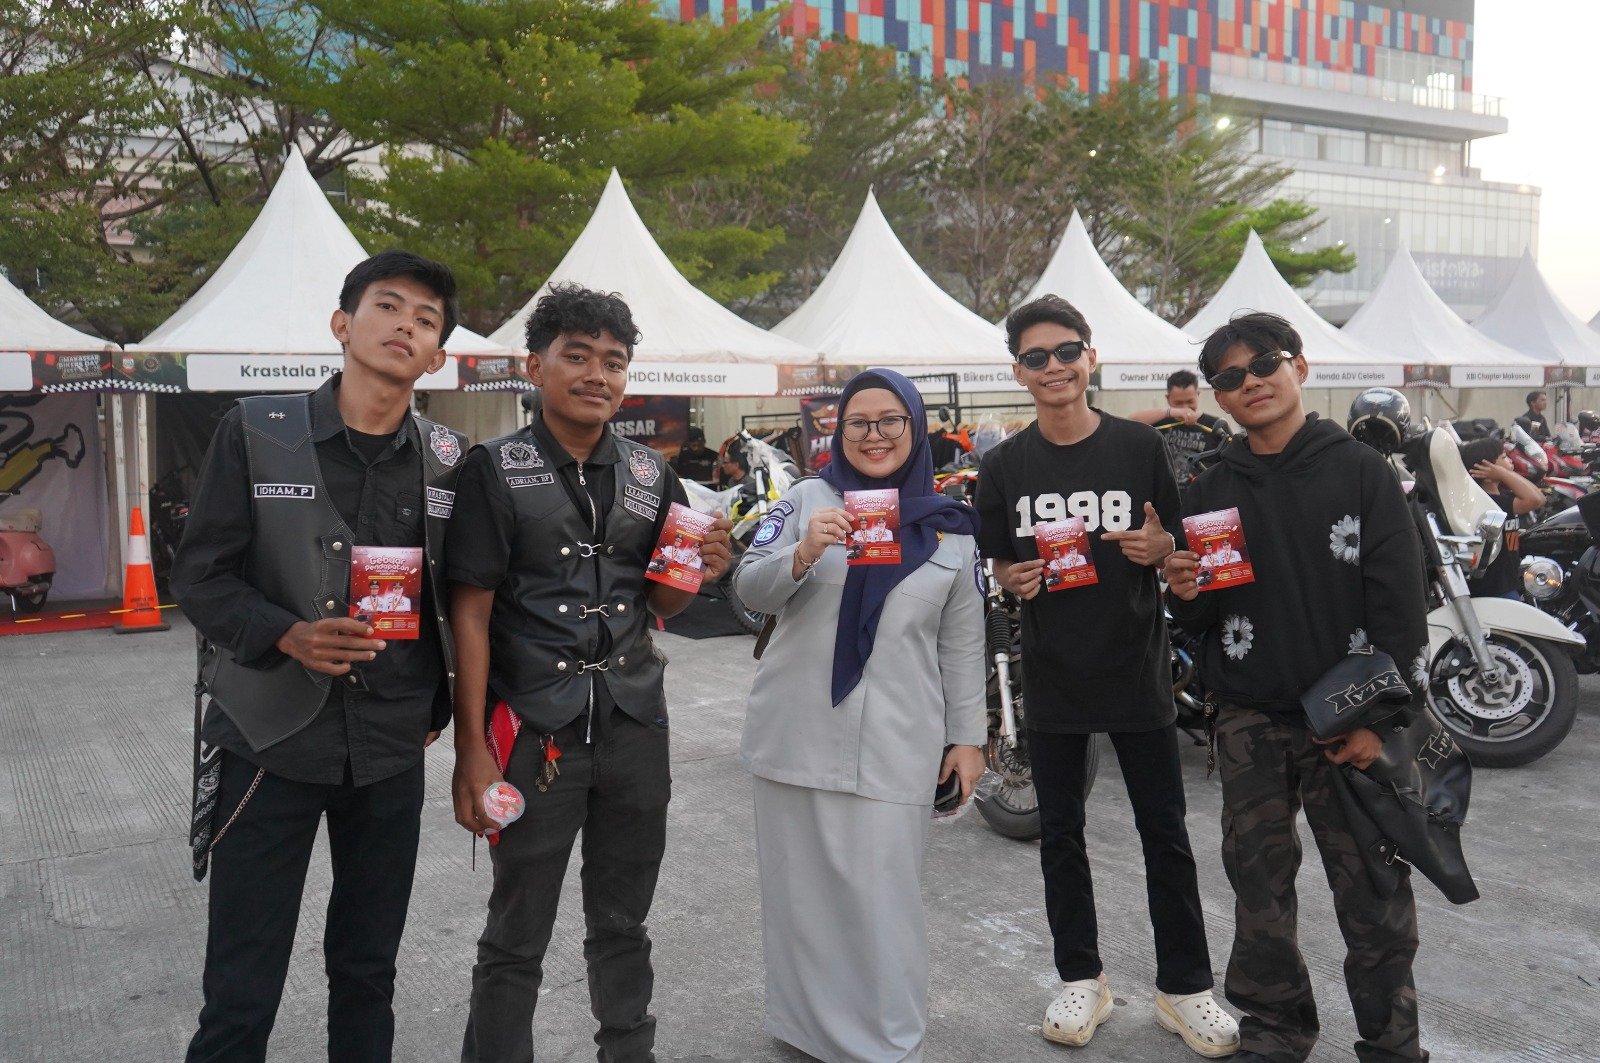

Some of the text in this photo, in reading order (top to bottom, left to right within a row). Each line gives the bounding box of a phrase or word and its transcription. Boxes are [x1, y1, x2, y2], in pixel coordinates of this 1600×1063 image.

[240, 365, 340, 377] Krastala Pa
[1358, 372, 1385, 380] Celebes
[628, 371, 728, 383] HDCI Makassar
[964, 372, 995, 383] Bikers
[997, 372, 1016, 382] Clu
[1120, 373, 1170, 382] Owner XMA
[1478, 373, 1501, 382] Chapter
[259, 486, 309, 496] IDHAM. P
[628, 487, 658, 506] KRASTALA
[857, 496, 886, 505] Gebyar
[1015, 490, 1132, 538] 1998
[369, 555, 406, 565] Gebyar
